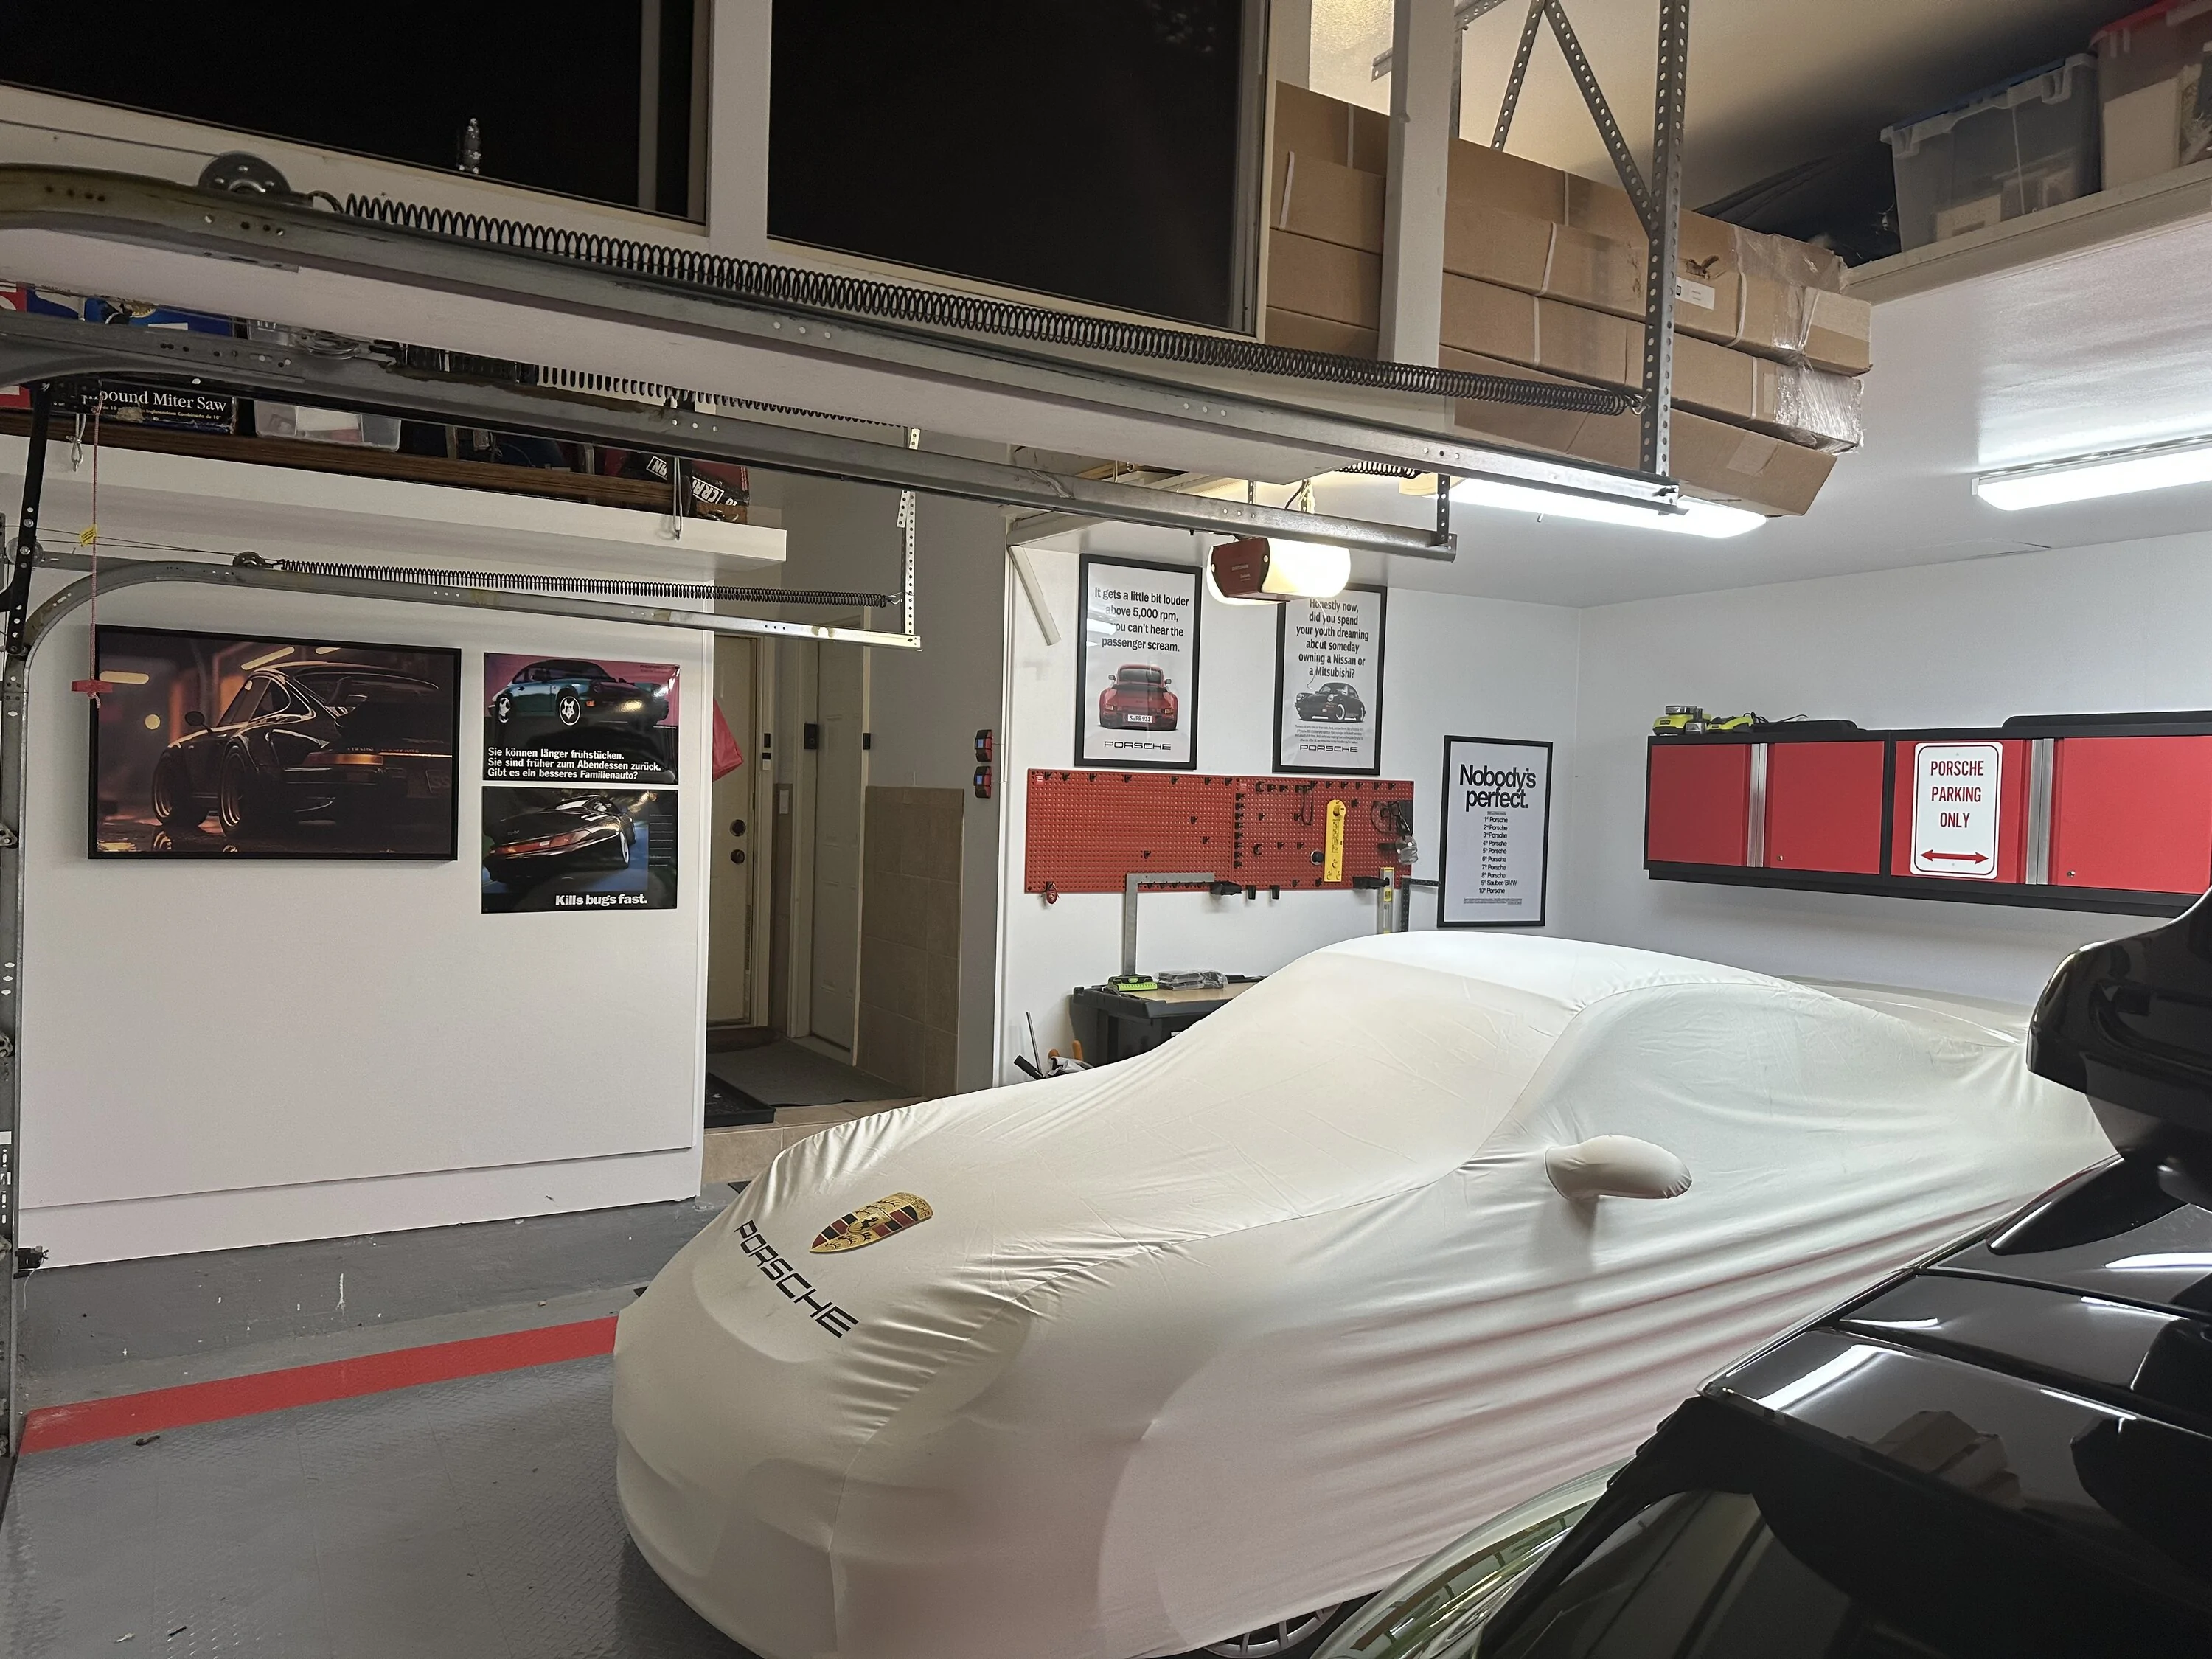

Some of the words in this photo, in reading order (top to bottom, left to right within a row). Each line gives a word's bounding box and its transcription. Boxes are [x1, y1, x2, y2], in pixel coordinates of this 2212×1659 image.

[153, 392, 194, 408] Miter
[197, 397, 227, 411] Saw
[1094, 587, 1101, 598] It
[1102, 589, 1121, 600] gets
[1123, 592, 1129, 600] a
[1130, 591, 1149, 602] little
[1151, 593, 1161, 604] bit
[1164, 594, 1189, 607] louder
[1105, 605, 1131, 616] above
[1133, 607, 1158, 619] 5,000
[1160, 611, 1179, 622] rpm,
[1310, 598, 1341, 613] Honestly
[1342, 603, 1359, 614] now,
[1309, 611, 1321, 622] did
[1322, 614, 1335, 625] you
[1337, 616, 1358, 626] spend
[1127, 623, 1149, 634] can't
[1150, 624, 1169, 636] hear
[1170, 626, 1184, 637] the
[1296, 625, 1313, 636] your
[1315, 626, 1335, 638] youth
[1337, 627, 1369, 642] dreaming
[1102, 637, 1147, 650] passenger
[1147, 641, 1180, 652] scream.
[1306, 639, 1327, 650] about
[1329, 641, 1360, 655] someday
[1298, 652, 1325, 665] owning
[1333, 654, 1356, 665] Nissan
[1357, 658, 1366, 666] or
[1309, 667, 1314, 676] a
[1315, 666, 1355, 678] Mitsubishi?
[488, 747, 503, 757] Sie
[505, 748, 538, 757] können
[540, 748, 568, 759] länger
[571, 750, 625, 760] frühstücken.
[1104, 741, 1172, 751] PORSCHE
[1300, 744, 1358, 753] PORSCHE
[487, 757, 503, 767] Sie
[504, 758, 524, 767] sind
[526, 758, 554, 768] früher
[577, 760, 628, 770] Abendessen
[630, 762, 661, 771] zurück.
[1930, 760, 1984, 776] PORSCHE
[487, 768, 507, 776] Gibt
[522, 768, 536, 777] ein
[538, 768, 578, 778] besseres
[580, 770, 639, 780] Familienauto?
[1459, 763, 1537, 793] Nobody's
[1465, 787, 1528, 813] perfect.
[1931, 786, 1981, 802] PARKING
[1940, 812, 1970, 828] ONLY
[555, 895, 584, 905] Kills
[585, 894, 617, 907] bugs
[618, 894, 648, 904] fast.
[734, 1220, 859, 1338] PORSCHE
